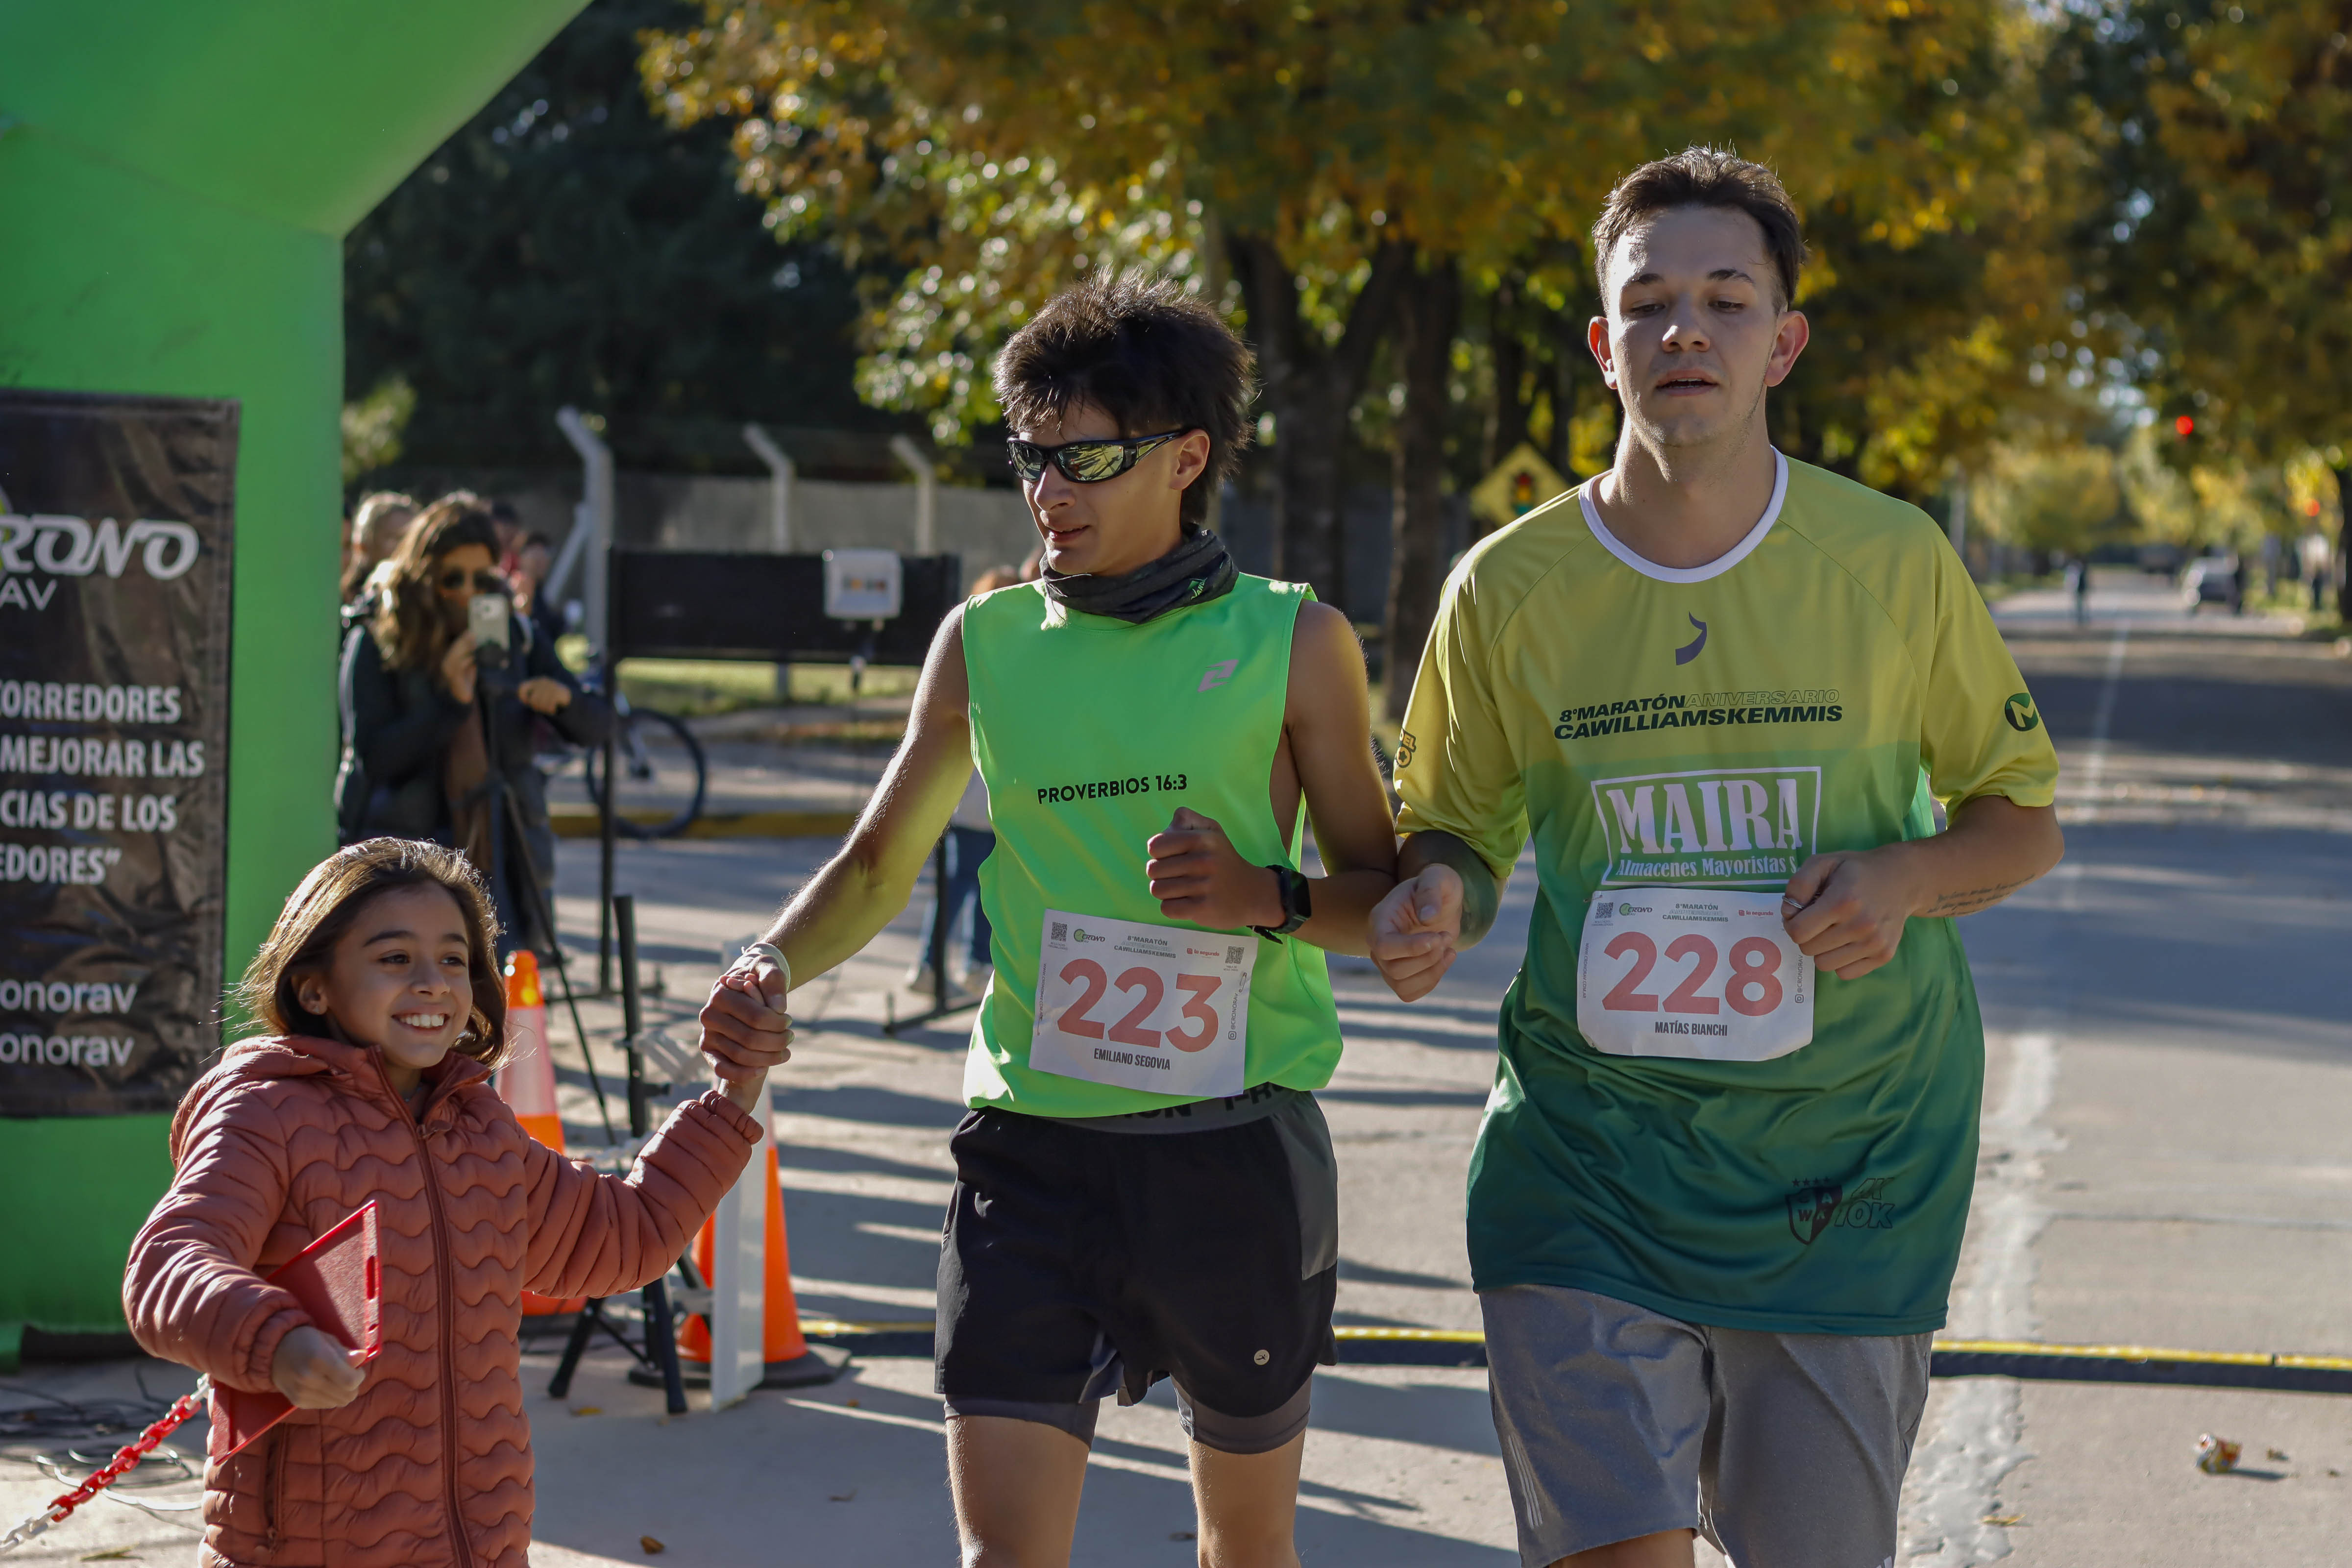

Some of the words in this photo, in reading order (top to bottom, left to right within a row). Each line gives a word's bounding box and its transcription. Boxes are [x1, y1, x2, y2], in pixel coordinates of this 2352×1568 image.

[0, 680, 181, 723] ORREDORES
[1554, 705, 1842, 740] CAWILLIAMSKEMMIS
[0, 735, 146, 776] MEJORAR
[151, 740, 205, 777] LAS
[1037, 776, 1150, 804] PROVERBIOS
[1155, 774, 1187, 791] 16:3
[1, 789, 68, 829] CIAS
[74, 792, 114, 831] DE
[122, 794, 177, 832] LOS
[1606, 778, 1803, 854] MAIRA
[1617, 859, 1697, 877] Almacenes
[1702, 856, 1787, 877] Mayoristas
[1114, 945, 1176, 959] CAWILLIAMSKEMMIS
[1602, 931, 1783, 1016] 228
[0, 979, 137, 1013] onorav
[1057, 958, 1222, 1053] 223
[1655, 1020, 1690, 1035] MATÍAS
[1691, 1023, 1728, 1036] BIANCHI
[0, 1032, 135, 1066] onorav
[1094, 1048, 1133, 1065] EMILIANO
[1135, 1054, 1171, 1071] SEGOVIA
